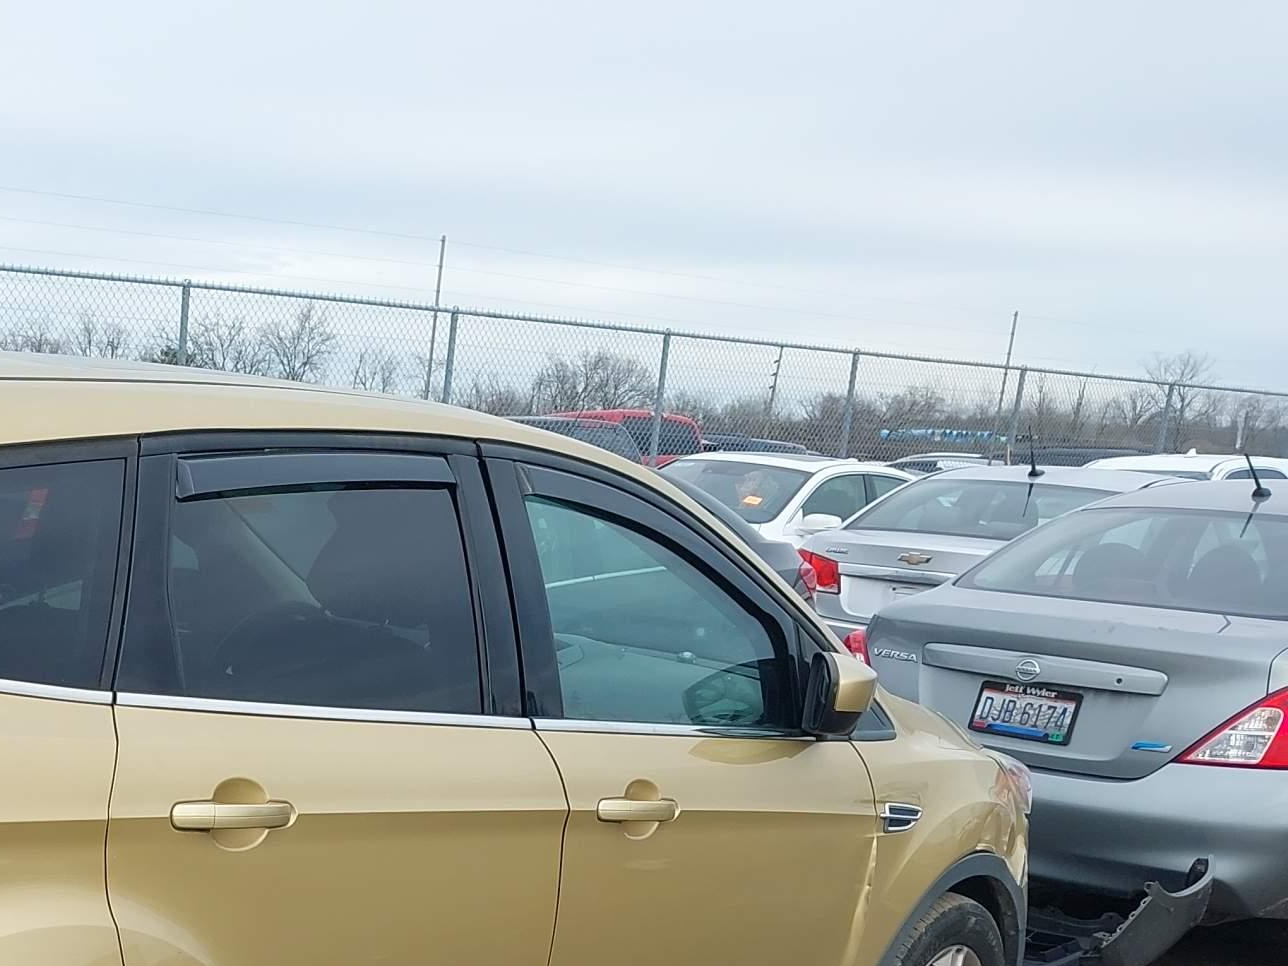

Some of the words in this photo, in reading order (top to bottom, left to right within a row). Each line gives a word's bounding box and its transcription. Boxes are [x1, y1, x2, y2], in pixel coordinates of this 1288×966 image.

[874, 648, 917, 662] VERSA
[1005, 684, 1024, 693] Jeff
[1026, 687, 1058, 698] Wyler
[979, 697, 1016, 723] DJB
[1019, 703, 1067, 731] 6174
